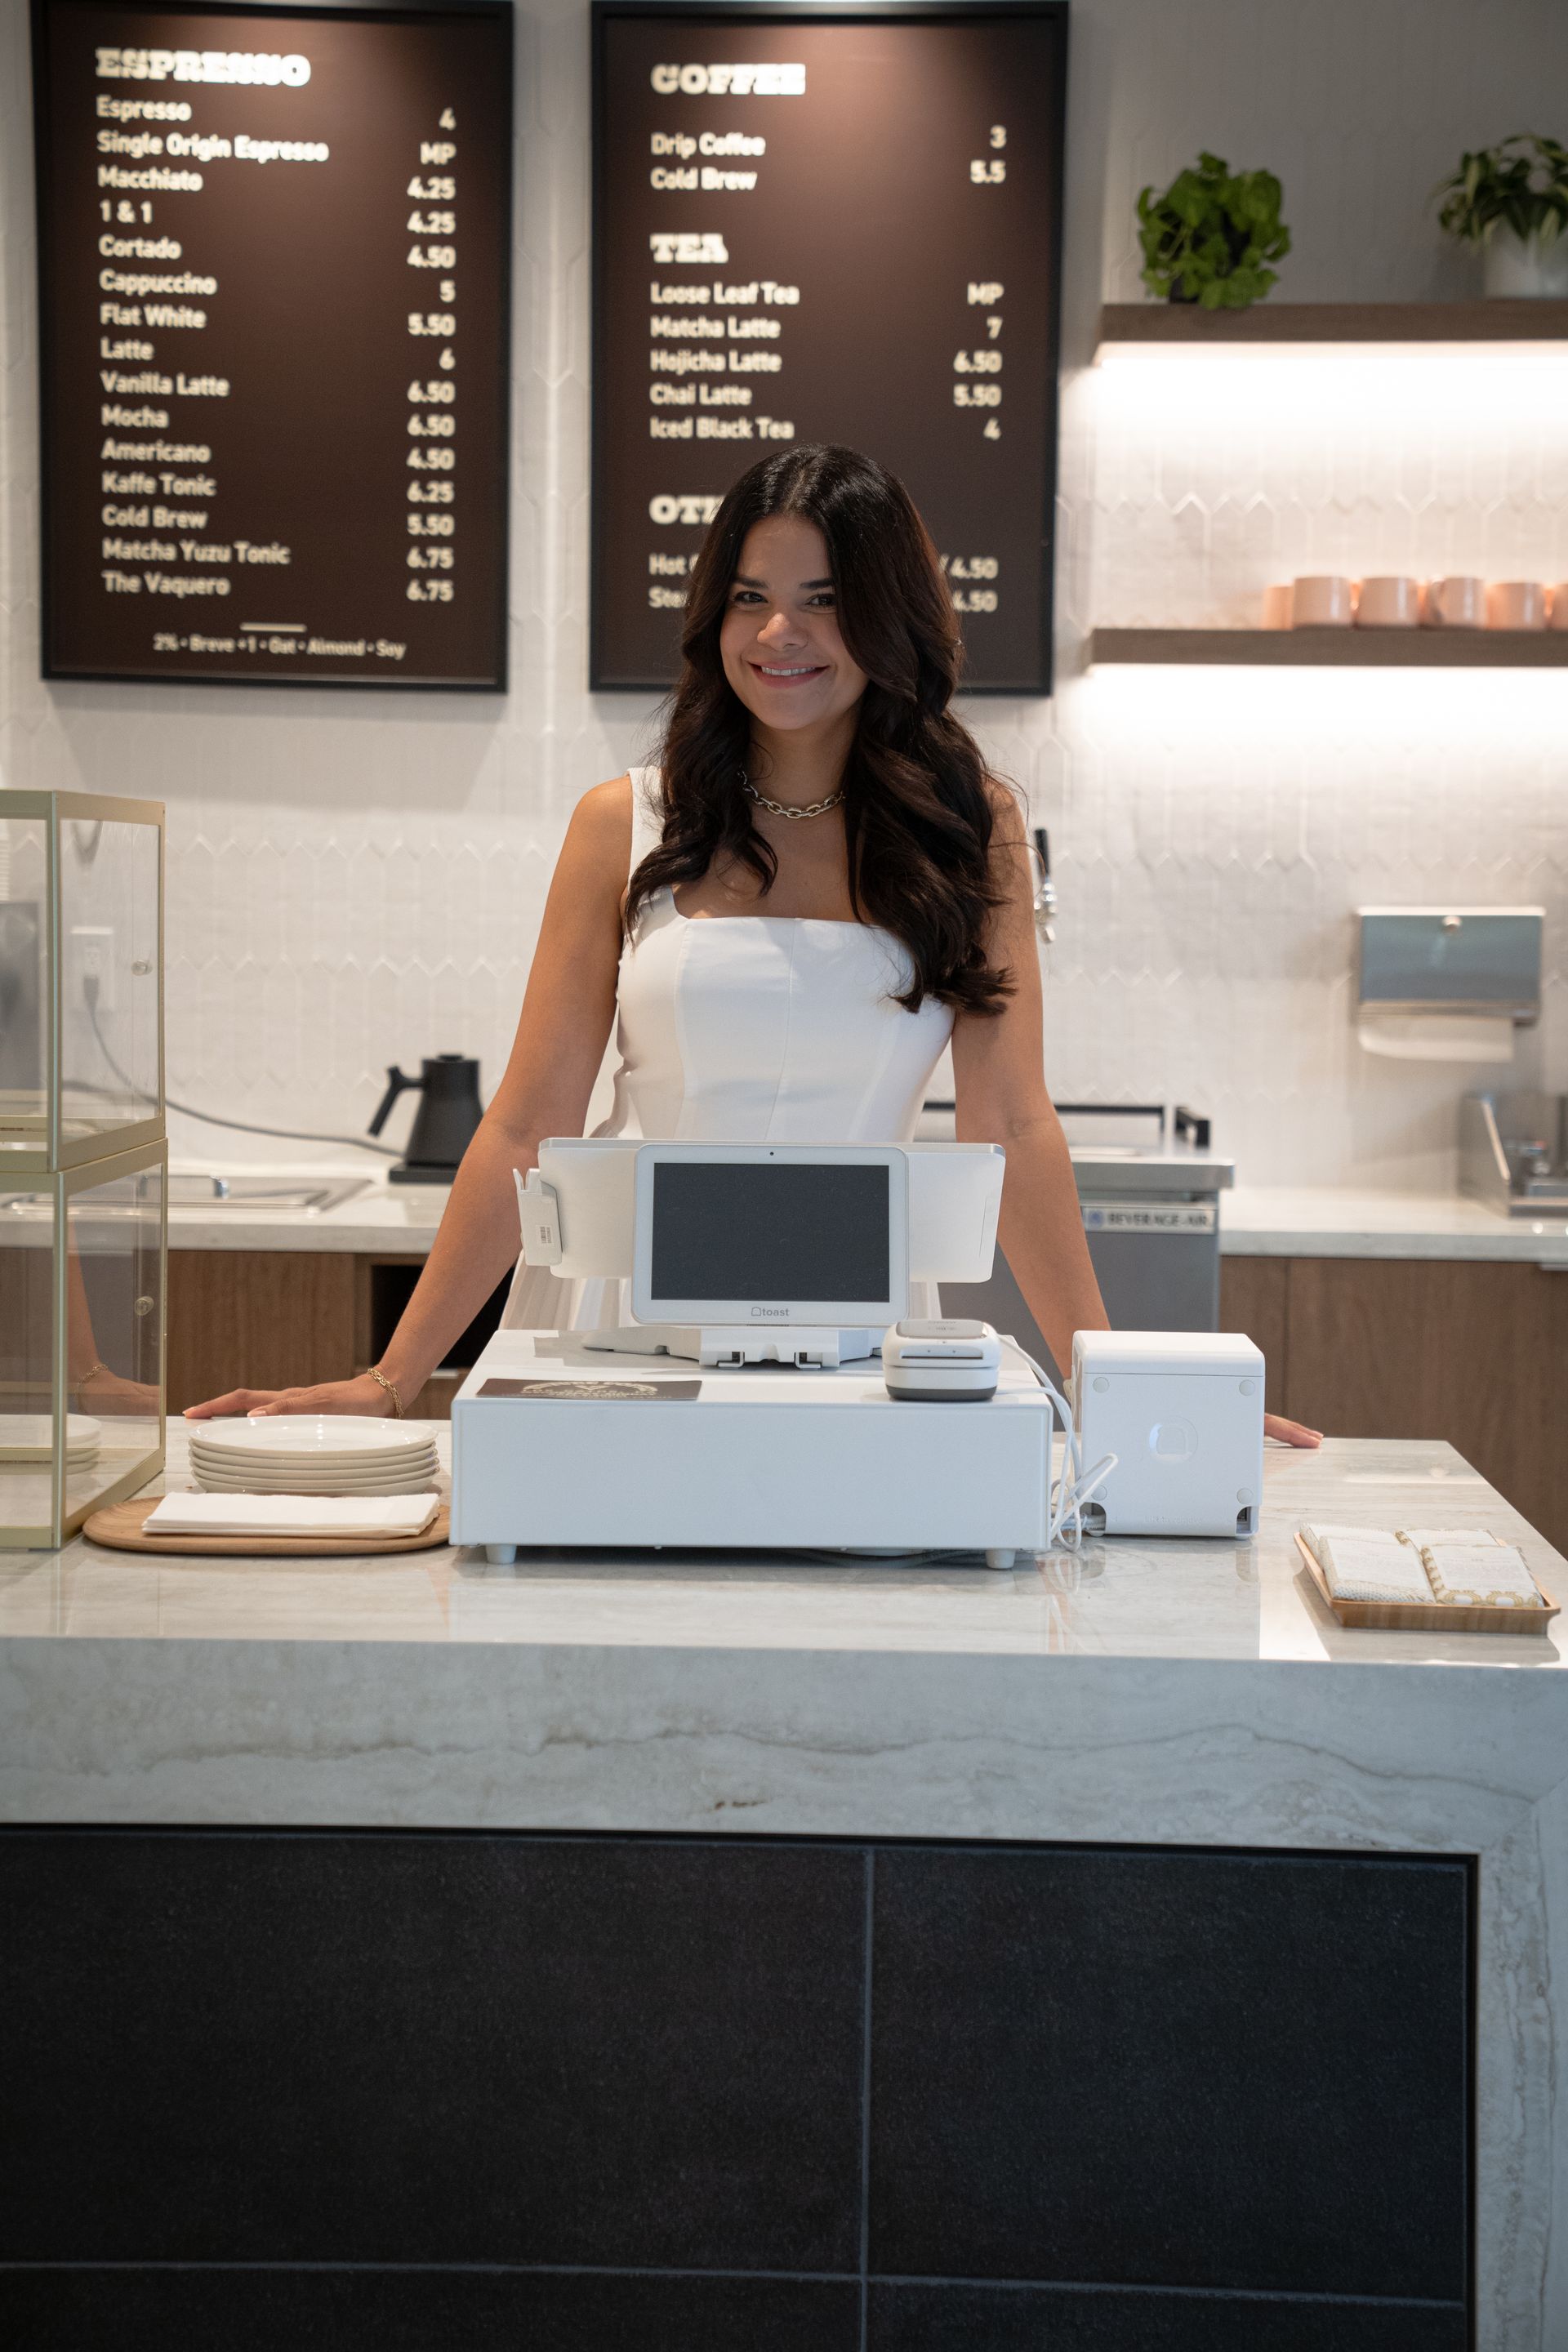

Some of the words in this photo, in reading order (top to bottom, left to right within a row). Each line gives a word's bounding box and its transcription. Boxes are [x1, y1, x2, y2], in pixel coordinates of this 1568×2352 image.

[96, 48, 311, 87] ESPRESSO
[651, 64, 806, 96] COFFEE
[97, 96, 193, 122] Espresso
[439, 108, 456, 131] 4
[97, 130, 164, 159] Single
[166, 132, 232, 163] Origin
[234, 135, 330, 164] Espresso
[651, 132, 697, 160] Drip
[698, 131, 767, 157] Coffee
[990, 125, 1007, 149] 3
[420, 141, 457, 165] MP
[98, 166, 204, 192] Macchiato
[650, 167, 699, 190] Cold
[701, 167, 758, 190] Brew
[970, 159, 1006, 184] 5.5
[407, 176, 456, 200] 4.25
[100, 199, 111, 222] 1
[117, 200, 136, 223] &
[140, 201, 152, 224] 1
[407, 211, 456, 234] 4.25
[99, 234, 182, 260] Cortado
[407, 245, 457, 269] 4.50
[649, 233, 729, 264] TEA
[99, 269, 218, 296] Cappuccino
[439, 279, 456, 303] 5
[650, 283, 711, 305] Loose
[713, 282, 759, 305] Leaf
[760, 282, 800, 305] Tea
[967, 283, 1004, 305] MP
[100, 302, 141, 326] Flat
[143, 305, 207, 329] White
[408, 313, 456, 336] 5.50
[650, 316, 725, 338] Matcha
[727, 316, 782, 339] Latte
[987, 316, 1003, 339] 7
[100, 337, 154, 361] Latte
[439, 348, 456, 370] 6
[650, 350, 727, 376] Hojicha
[728, 350, 782, 372] Latte
[953, 350, 1002, 373] 6.50
[100, 371, 174, 395] Vanilla
[176, 373, 230, 397] Latte
[407, 381, 456, 403] 6.50
[649, 382, 697, 405] Chai
[699, 384, 753, 406] Latte
[953, 384, 1002, 407] 5.50
[101, 404, 169, 428] Mocha
[407, 414, 456, 437] 6.50
[650, 417, 693, 439] Iced
[696, 416, 753, 439] Black
[755, 416, 795, 439] Tea
[983, 419, 1001, 440] 4
[101, 438, 212, 463] Americano
[406, 448, 455, 470] 4.50
[102, 471, 157, 495] Kaffe
[158, 473, 216, 497] Tonic
[407, 481, 455, 503] 6.25
[101, 504, 149, 528] Cold
[153, 506, 208, 529] Brew
[408, 513, 455, 537] 5.50
[102, 537, 177, 561] Matcha
[179, 540, 232, 563] Yuzu
[234, 541, 290, 564] Tonic
[407, 546, 454, 569] 6.75
[648, 552, 687, 577] Hot
[951, 556, 999, 579] 4.50
[101, 570, 142, 593] The
[144, 572, 231, 599] Vaquero
[406, 579, 454, 602] 6.75
[189, 634, 235, 653] Breve
[306, 638, 366, 657] Almond
[376, 639, 407, 660] Soy
[762, 1307, 790, 1316] toast
